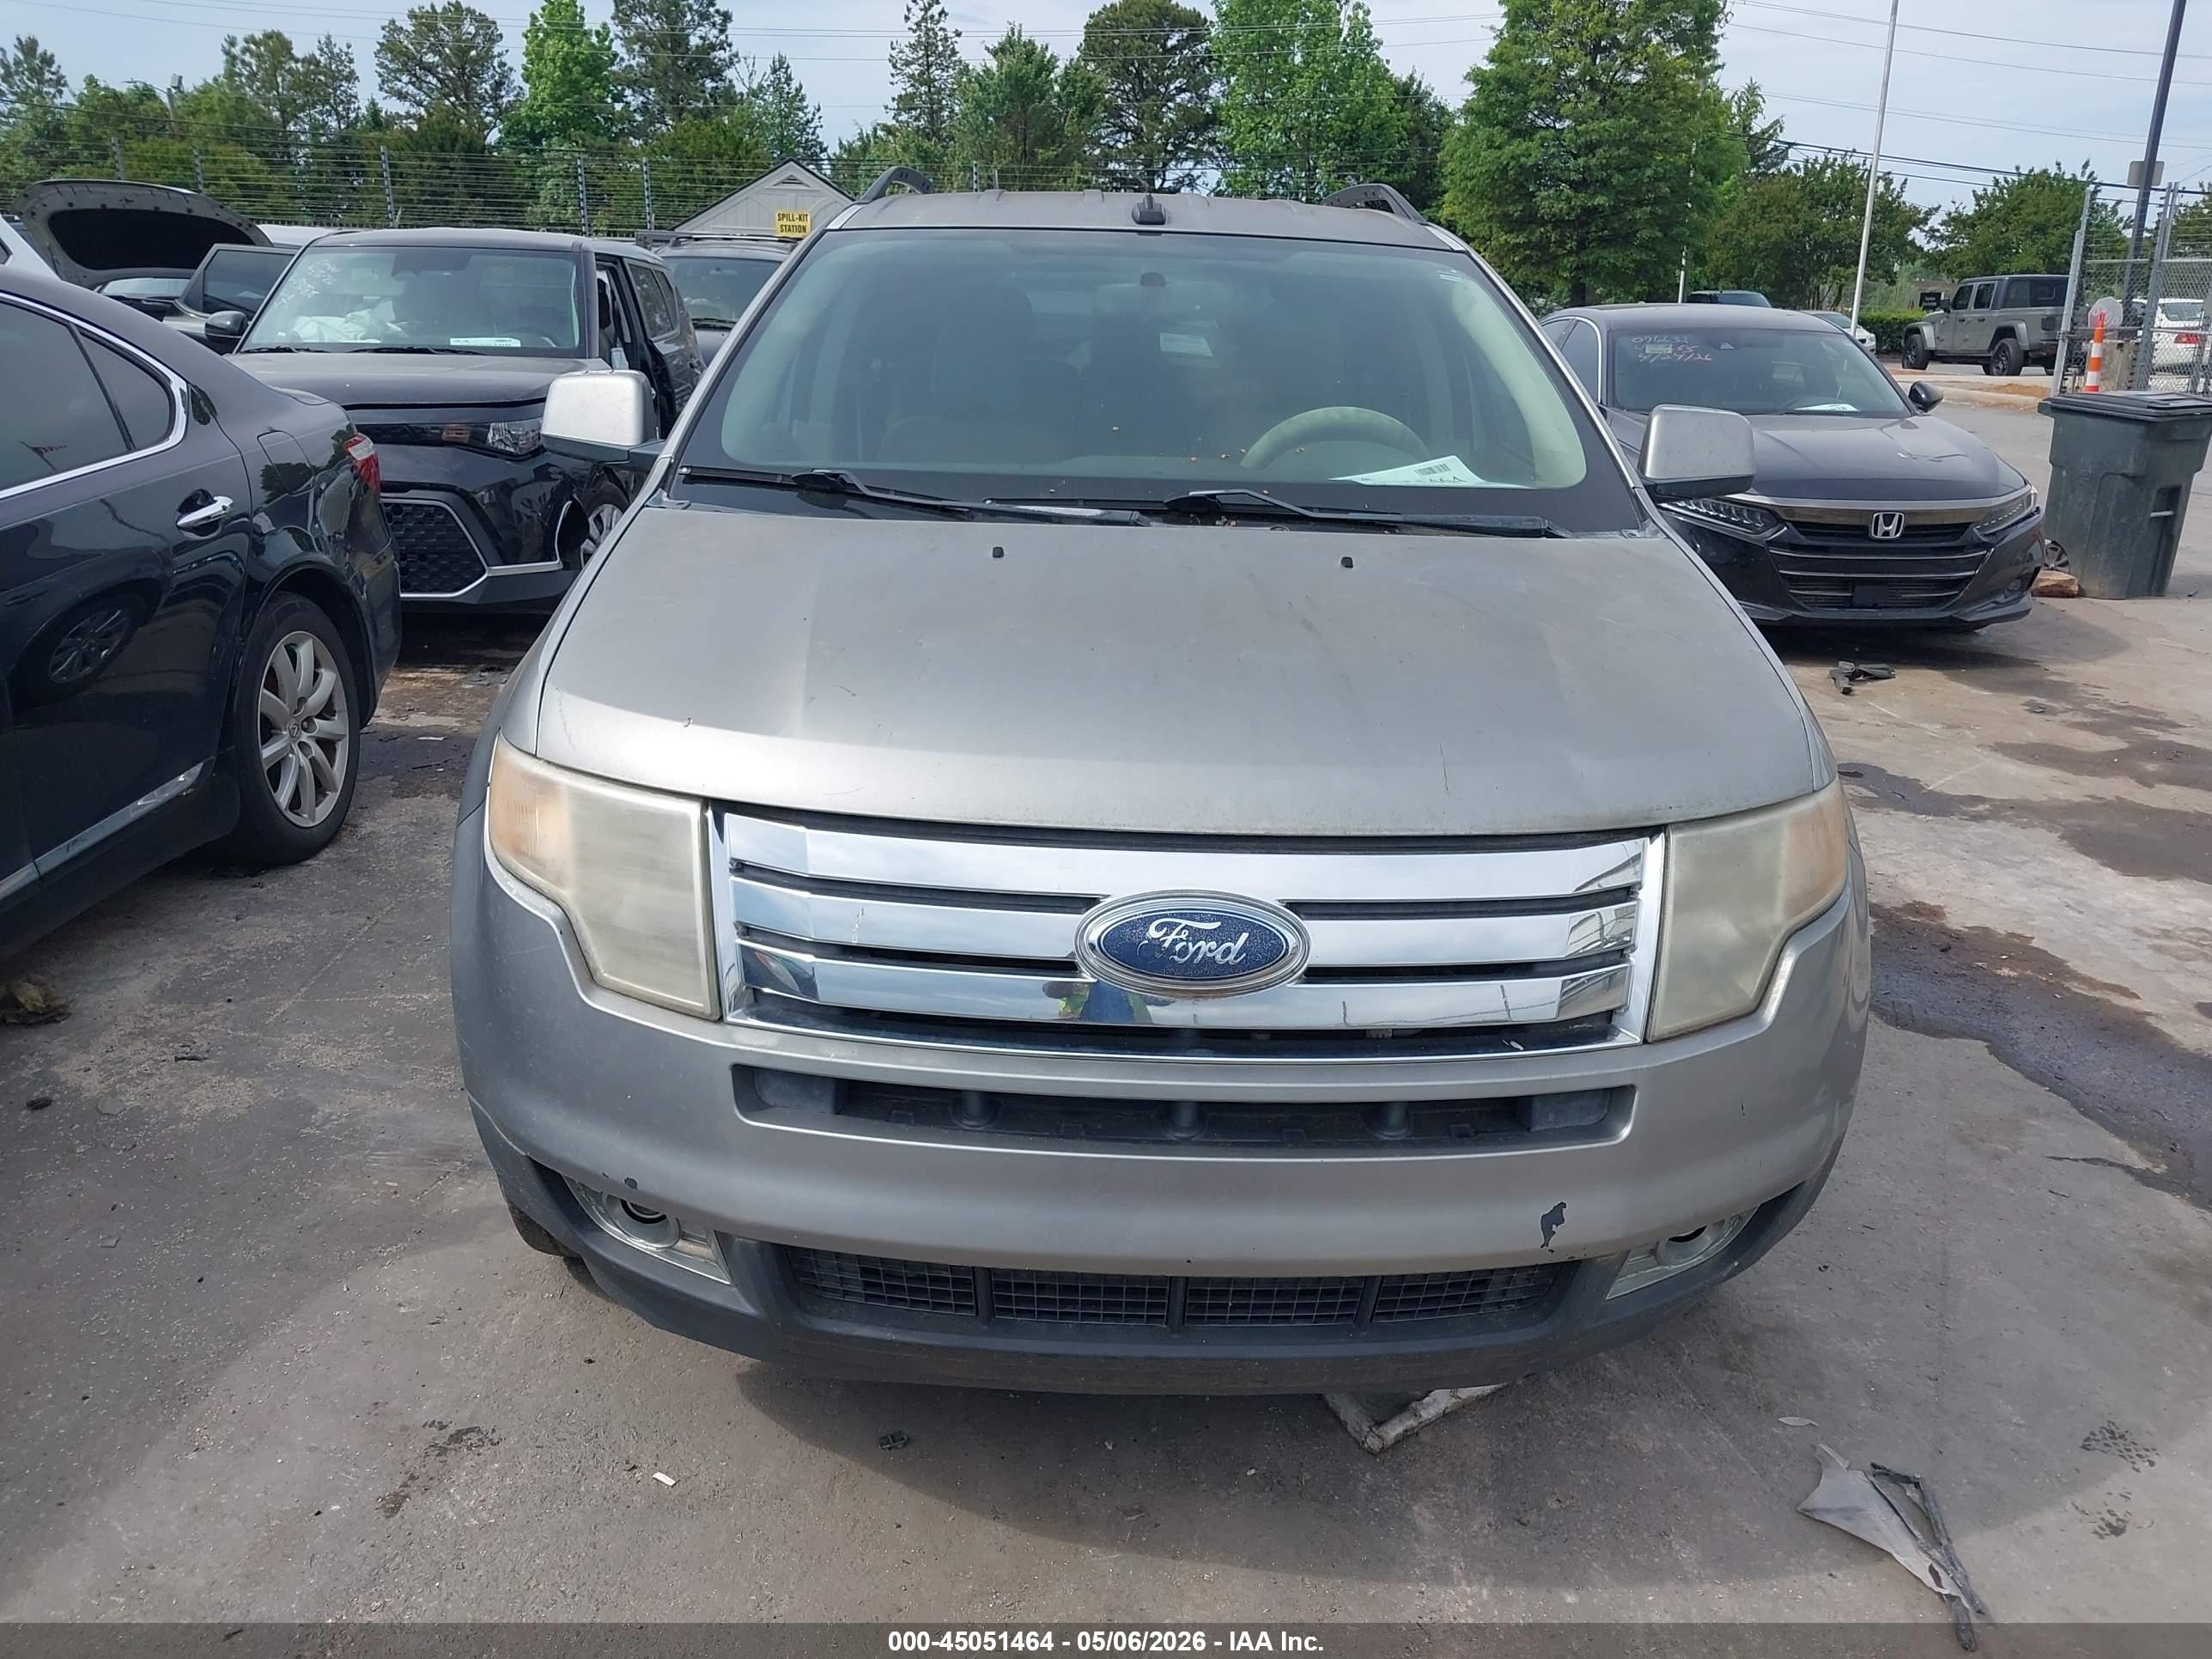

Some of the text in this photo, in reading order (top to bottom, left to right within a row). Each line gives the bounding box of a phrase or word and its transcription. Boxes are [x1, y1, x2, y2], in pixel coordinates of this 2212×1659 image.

[777, 213, 808, 222] SPILL-KIT
[780, 224, 806, 234] STATION
[1138, 918, 1249, 964] Ford
